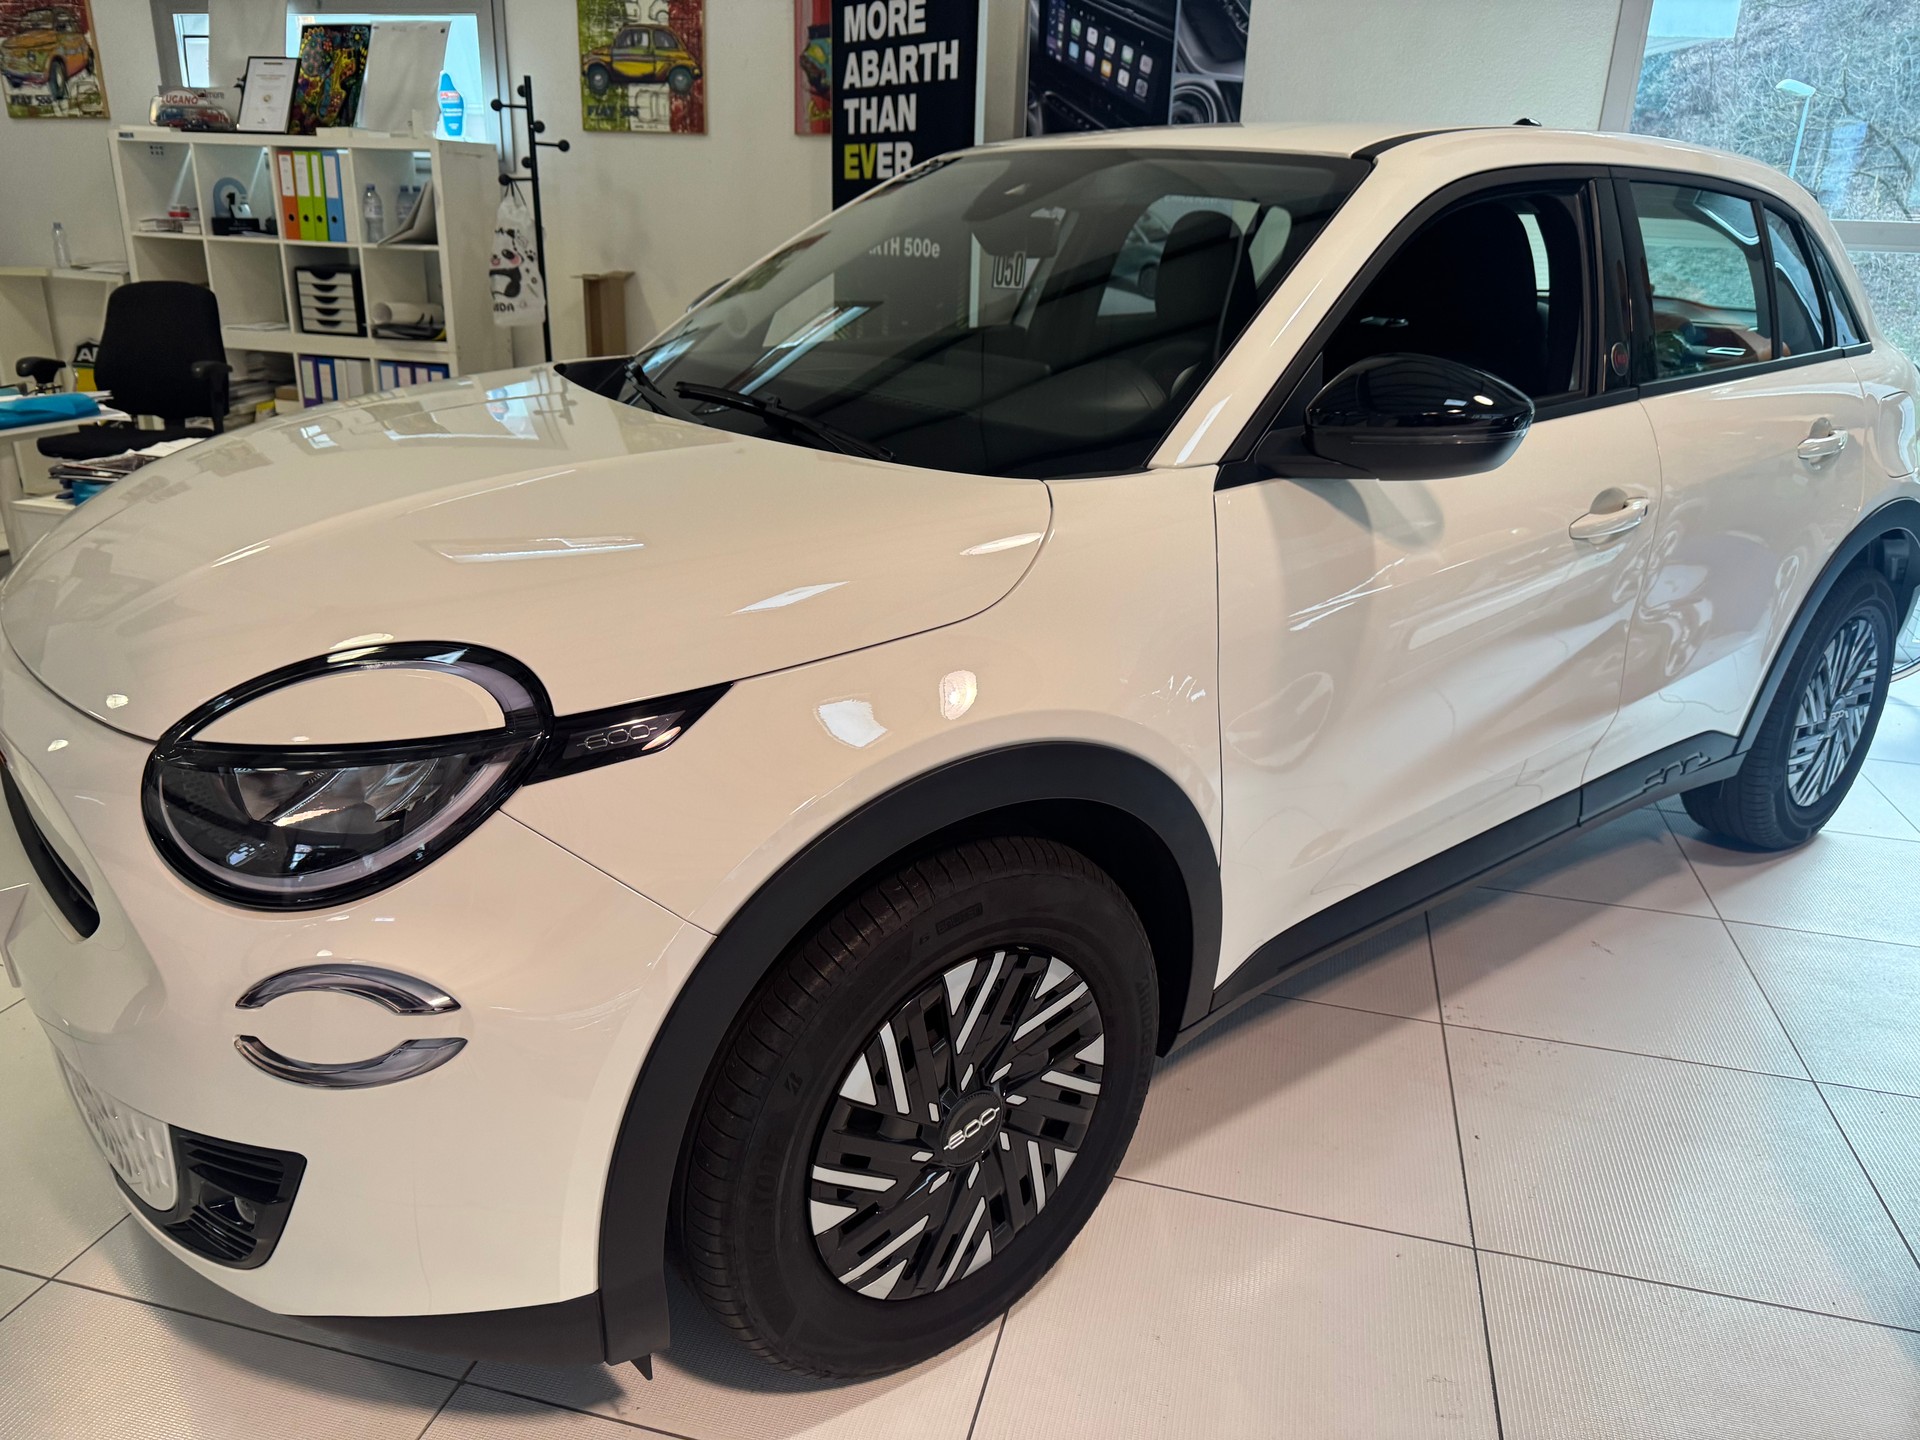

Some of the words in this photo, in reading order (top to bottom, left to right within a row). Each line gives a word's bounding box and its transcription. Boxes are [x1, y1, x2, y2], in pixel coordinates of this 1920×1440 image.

[843, 0, 927, 43] MORE
[842, 38, 960, 90] ABARTH
[842, 92, 917, 135] THAN
[843, 141, 915, 180] EVER
[903, 237, 941, 258] 500e
[577, 724, 658, 750] 600
[943, 1106, 1000, 1150] 600
